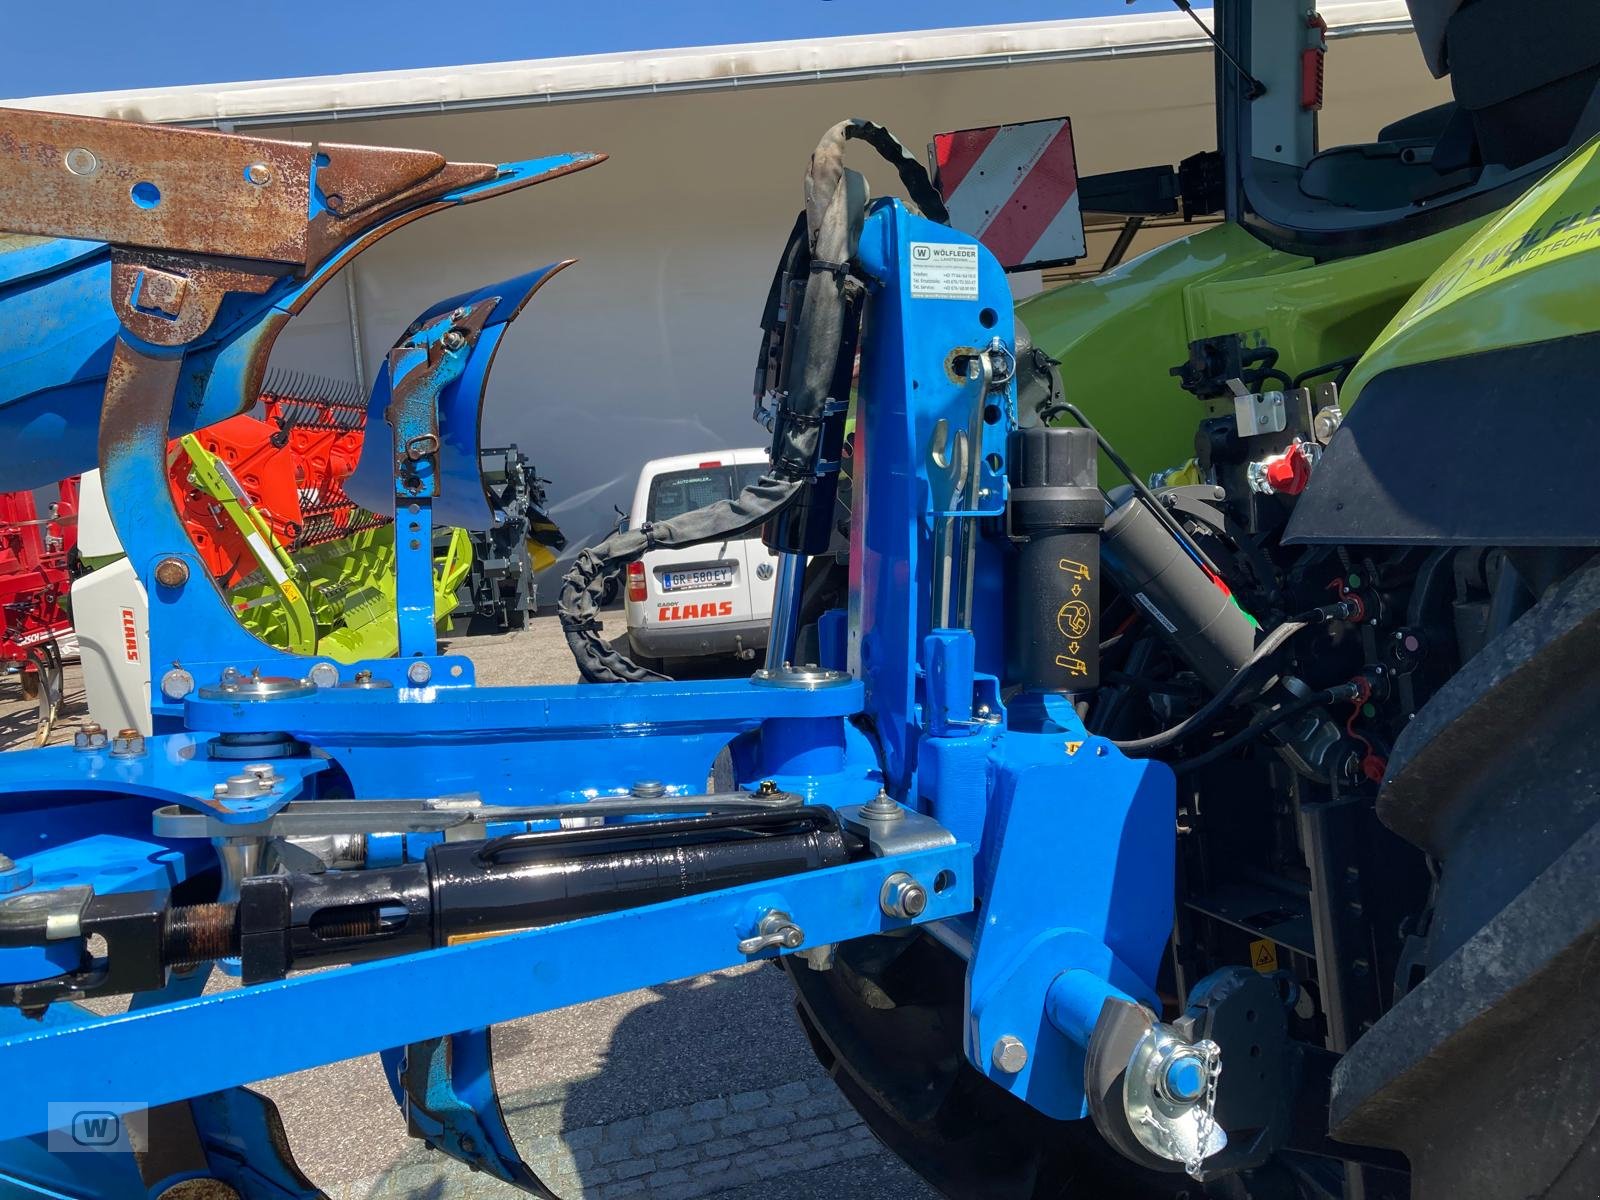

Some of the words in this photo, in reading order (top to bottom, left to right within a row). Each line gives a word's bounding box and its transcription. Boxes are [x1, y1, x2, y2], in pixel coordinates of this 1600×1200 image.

[933, 248, 976, 258] WÖLFLEDER
[673, 573, 686, 585] GR
[658, 601, 733, 622] CLAAS
[122, 609, 139, 661] CLAAS
